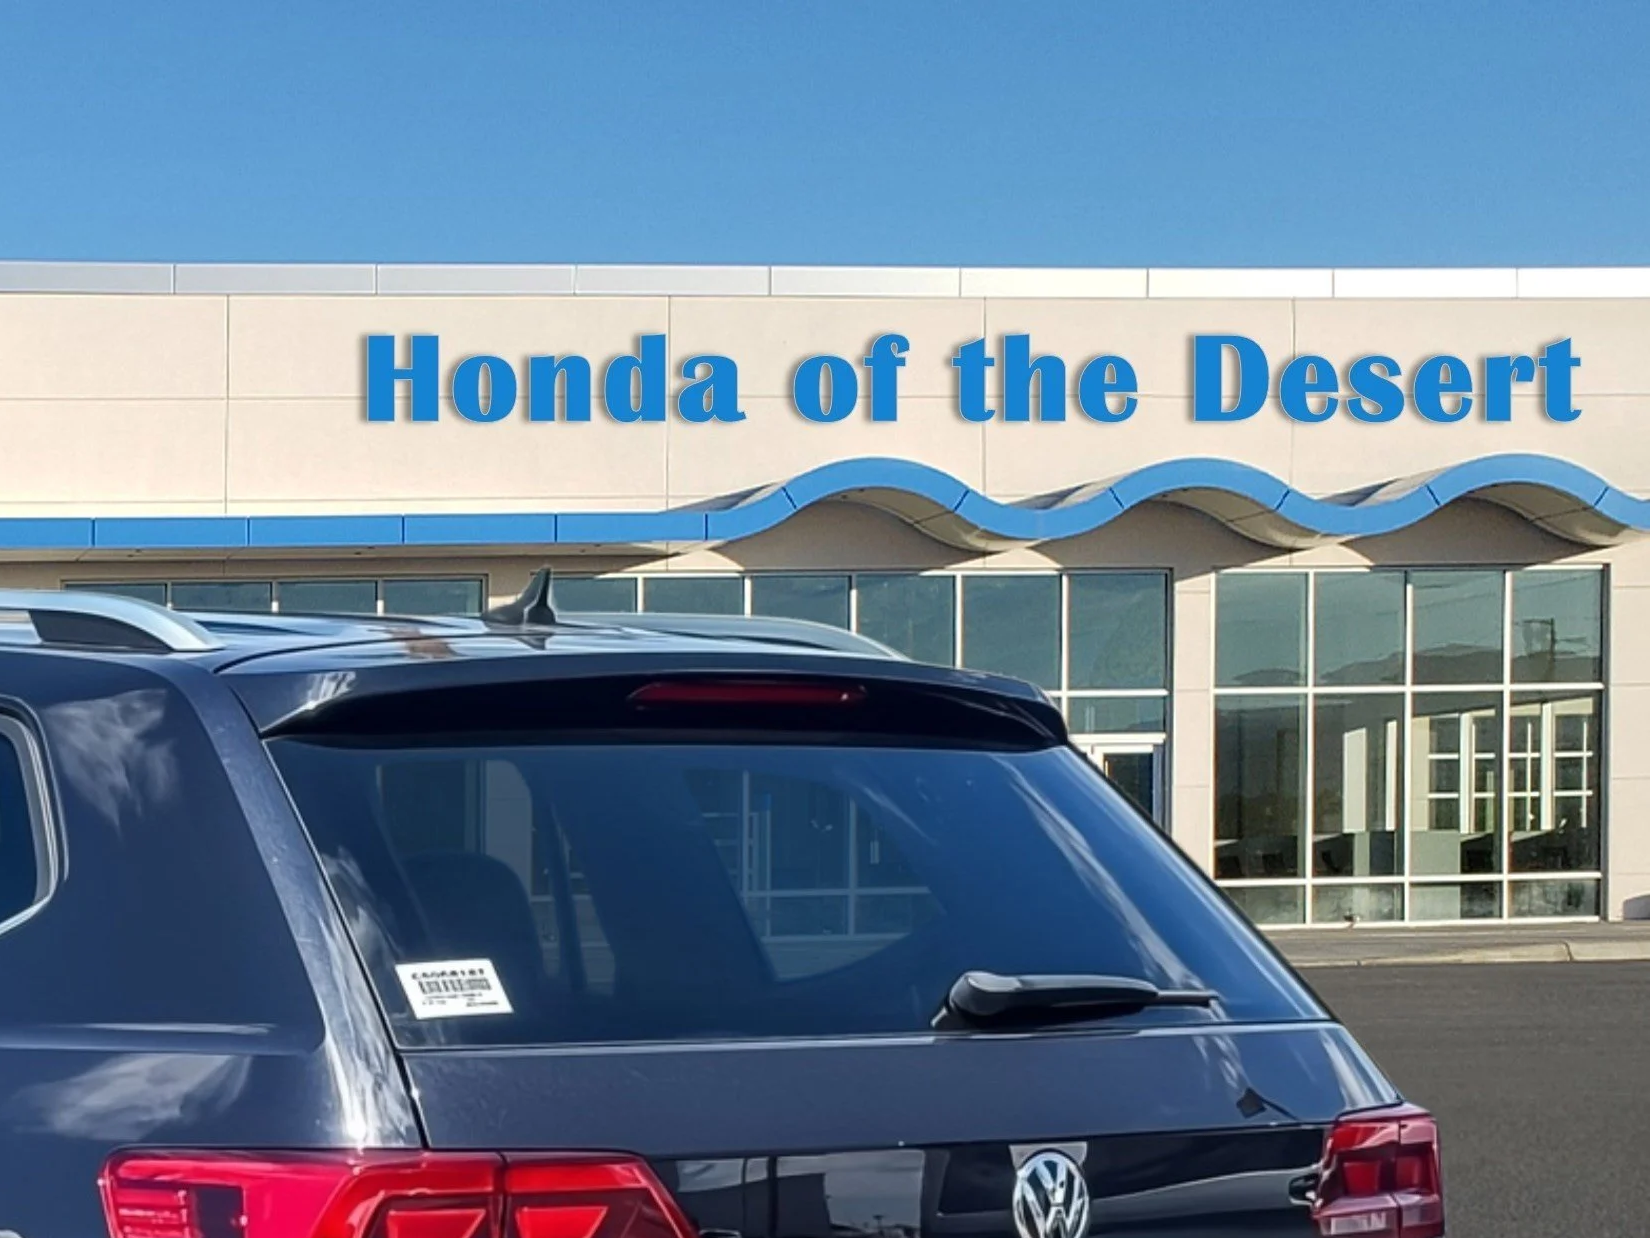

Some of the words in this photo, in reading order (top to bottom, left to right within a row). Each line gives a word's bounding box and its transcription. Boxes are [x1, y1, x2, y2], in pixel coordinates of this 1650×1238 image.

[366, 332, 747, 423] Honda
[793, 332, 911, 423] of
[951, 332, 1139, 423] the
[1193, 334, 1583, 423] Desert
